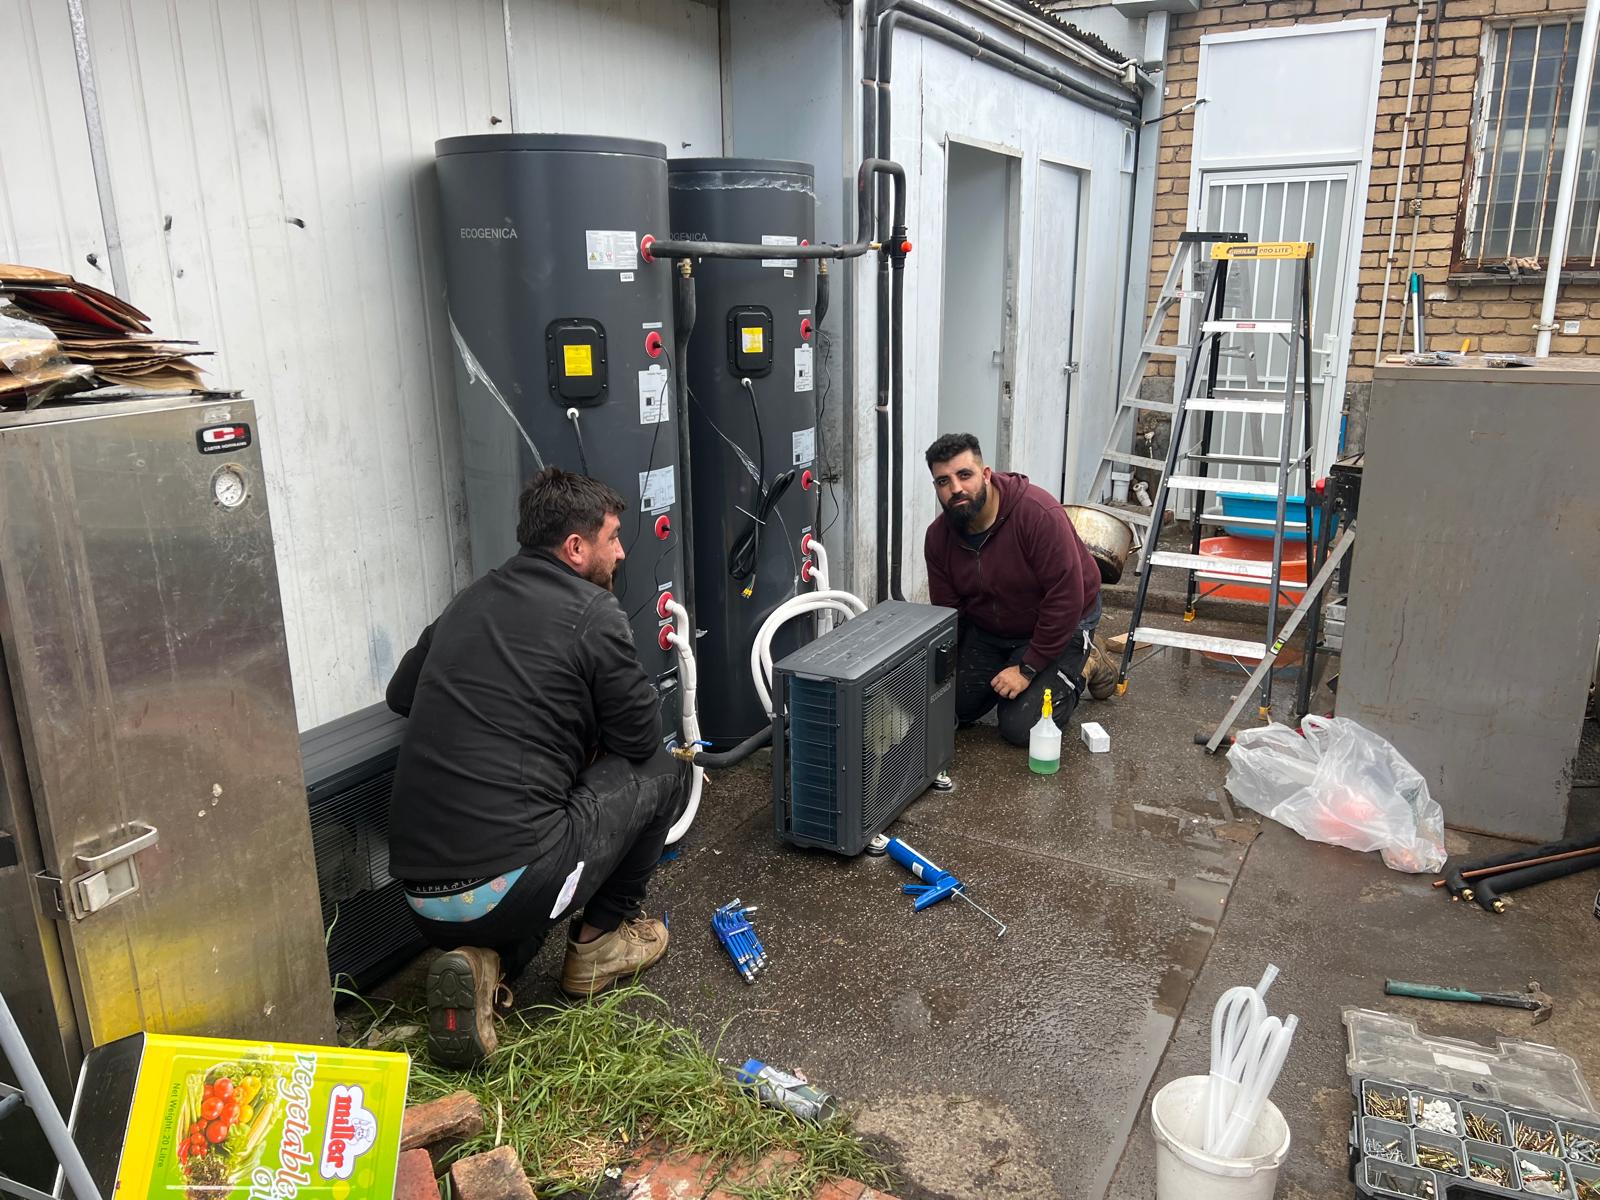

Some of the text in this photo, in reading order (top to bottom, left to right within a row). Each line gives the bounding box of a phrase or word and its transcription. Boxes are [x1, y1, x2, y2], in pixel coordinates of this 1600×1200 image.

[460, 227, 518, 239] ECOGENICA
[171, 1082, 181, 1097] Net
[277, 1053, 317, 1198] vegetable
[326, 1094, 356, 1169] miller
[161, 1135, 171, 1145] 20
[158, 1147, 168, 1168] Litre
